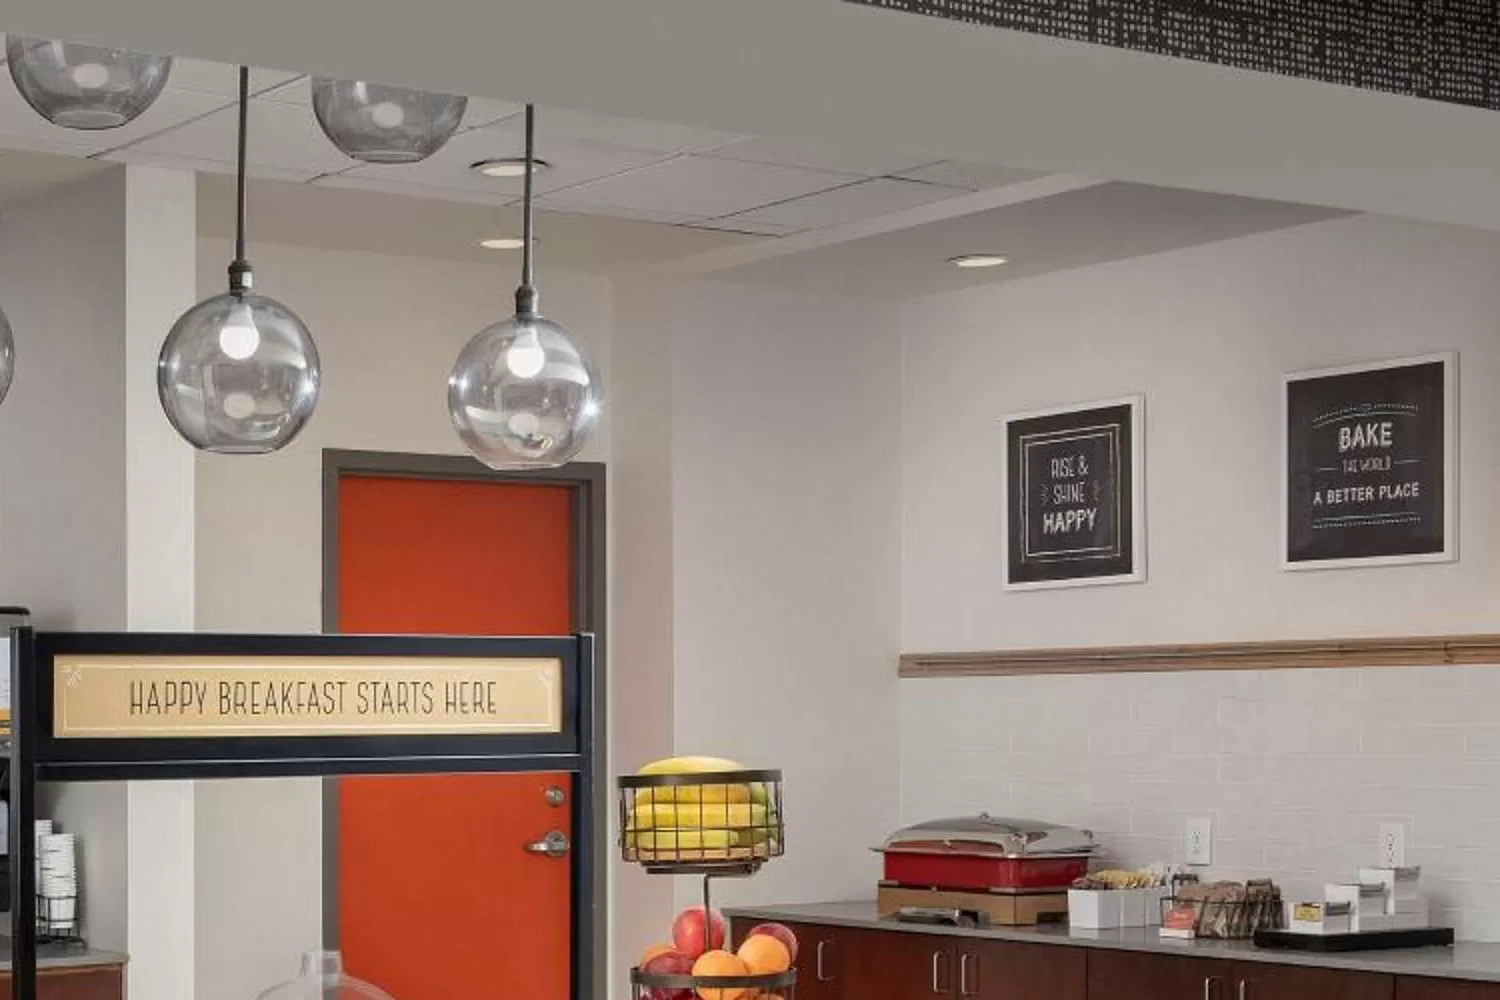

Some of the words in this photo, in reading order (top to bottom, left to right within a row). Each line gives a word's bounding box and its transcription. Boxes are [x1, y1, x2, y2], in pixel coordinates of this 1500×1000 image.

[1338, 421, 1393, 452] BAKE
[1051, 456, 1076, 478] RISE
[1077, 454, 1089, 476] &
[1053, 481, 1085, 505] SHINE
[1312, 491, 1323, 507] A
[1326, 486, 1375, 505] BETTER
[1379, 481, 1420, 501] PLACE
[1043, 507, 1098, 536] HAPPY
[129, 680, 207, 716] HAPPY
[218, 680, 348, 716] BREAKFAST
[356, 680, 435, 716] STARTS
[444, 680, 498, 715] HERE
